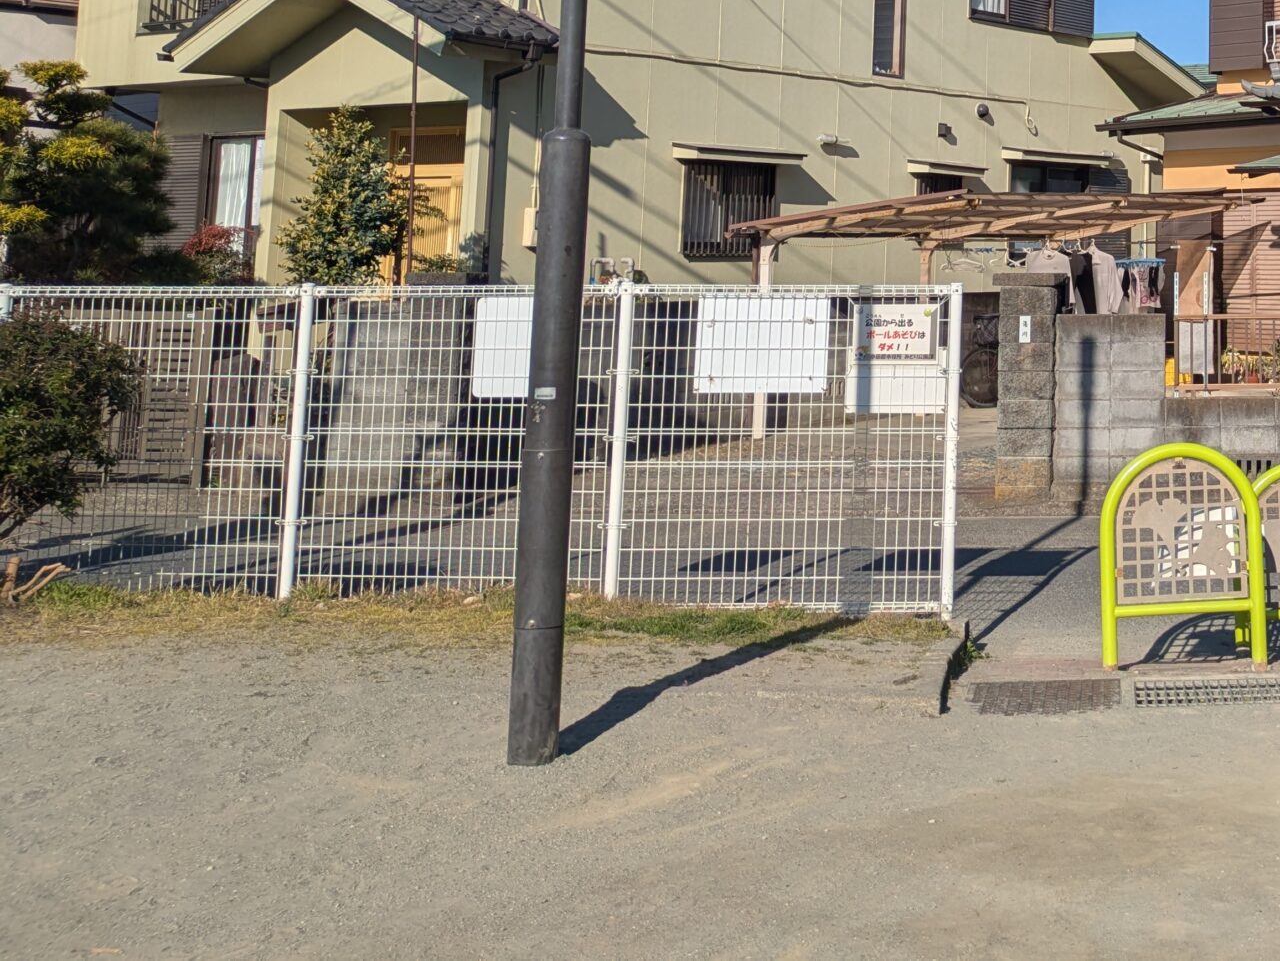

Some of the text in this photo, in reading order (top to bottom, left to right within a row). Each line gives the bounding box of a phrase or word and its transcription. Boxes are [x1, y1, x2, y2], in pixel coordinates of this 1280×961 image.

[865, 318, 914, 328] 公園から出る
[866, 329, 926, 340] ボールあそびは
